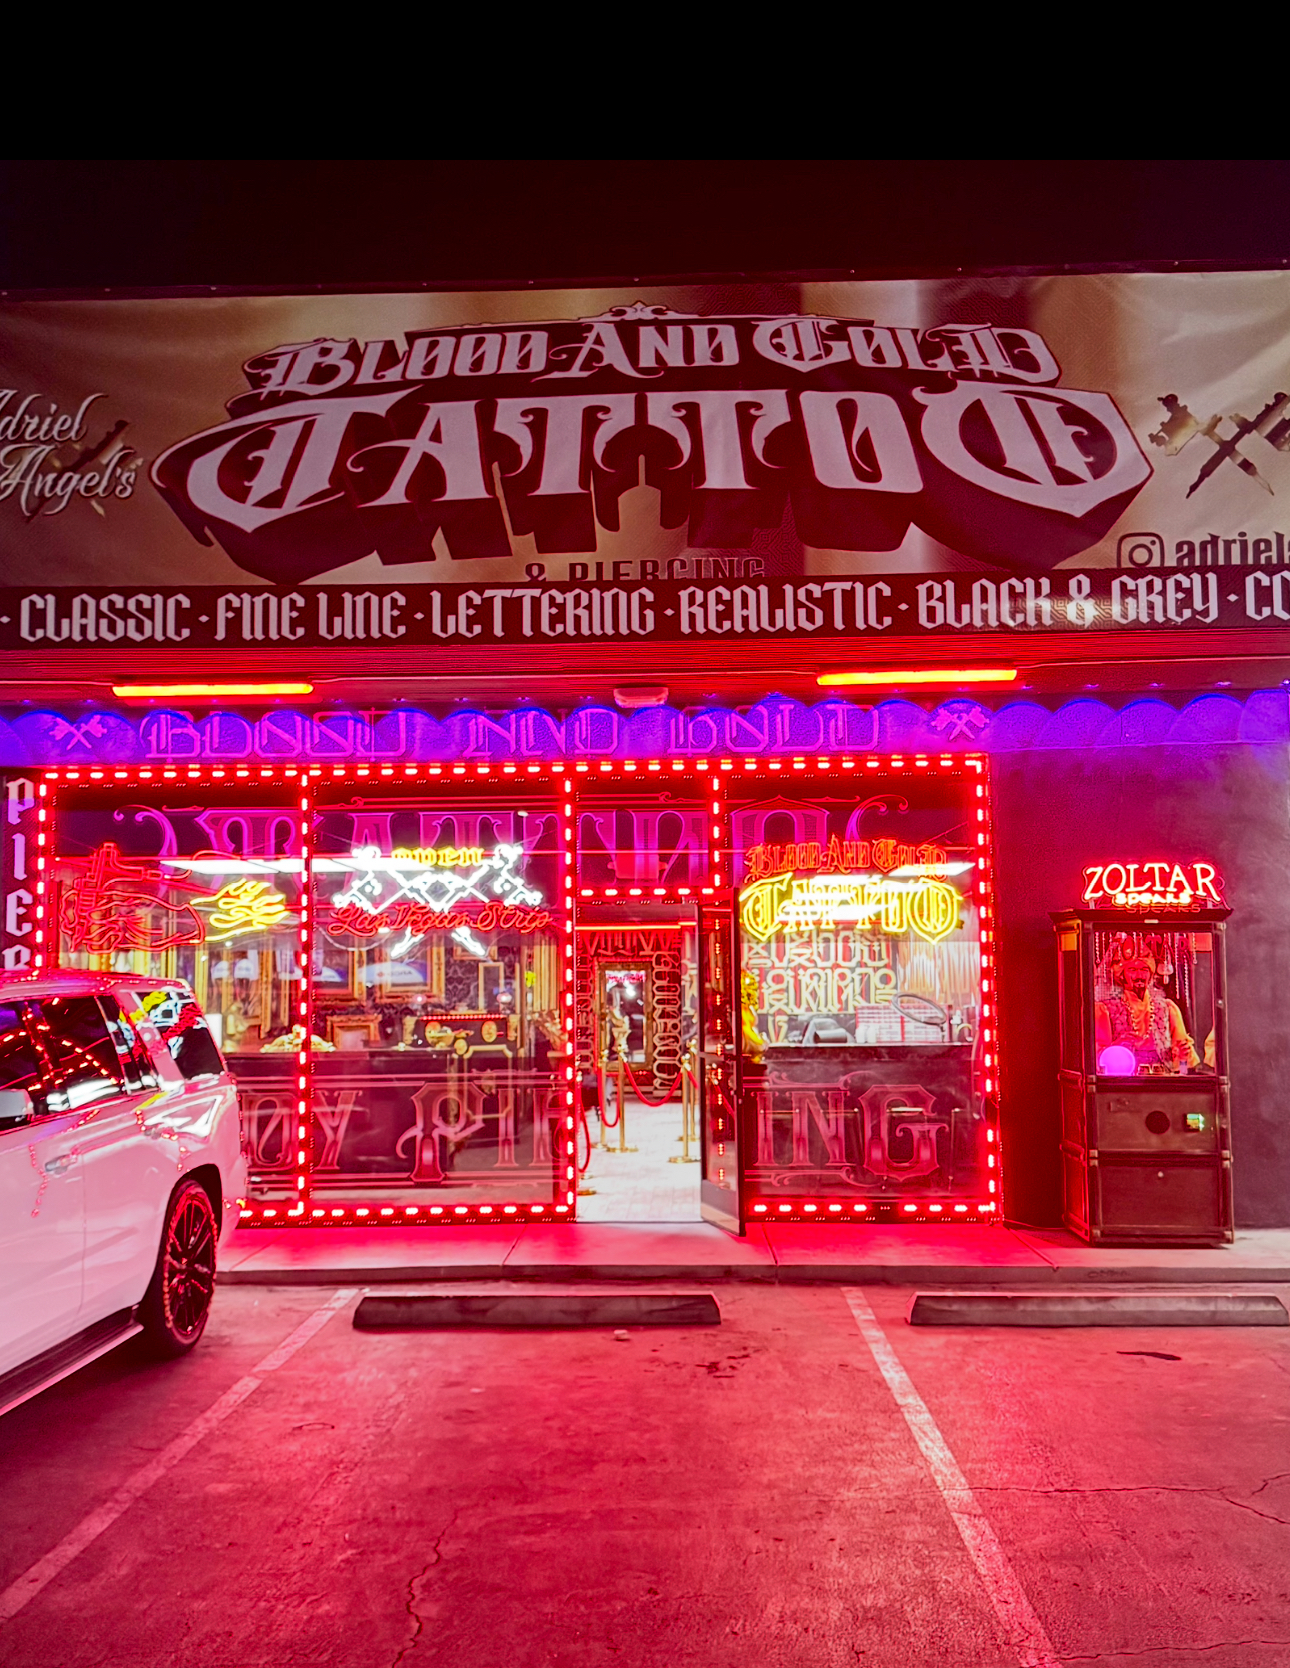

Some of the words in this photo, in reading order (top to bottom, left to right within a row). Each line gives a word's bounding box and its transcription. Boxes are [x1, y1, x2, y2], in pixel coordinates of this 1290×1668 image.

[243, 332, 549, 395] BLOOD
[0, 443, 136, 517] Angel's
[152, 379, 1153, 533] TATTOO
[1175, 531, 1290, 566] adriel
[20, 593, 191, 642] CLASSIC
[214, 592, 305, 641] FINE
[317, 591, 406, 641] LINE
[431, 587, 655, 638] LETTERING
[678, 582, 892, 635] REALISTIC
[916, 577, 1051, 630] BLACK
[1067, 573, 1098, 627] &
[1111, 572, 1219, 625] GREY
[1083, 862, 1222, 902] ZOLTAR
[326, 904, 391, 938] Las
[391, 904, 470, 938] Vegas
[470, 900, 554, 935] Strip
